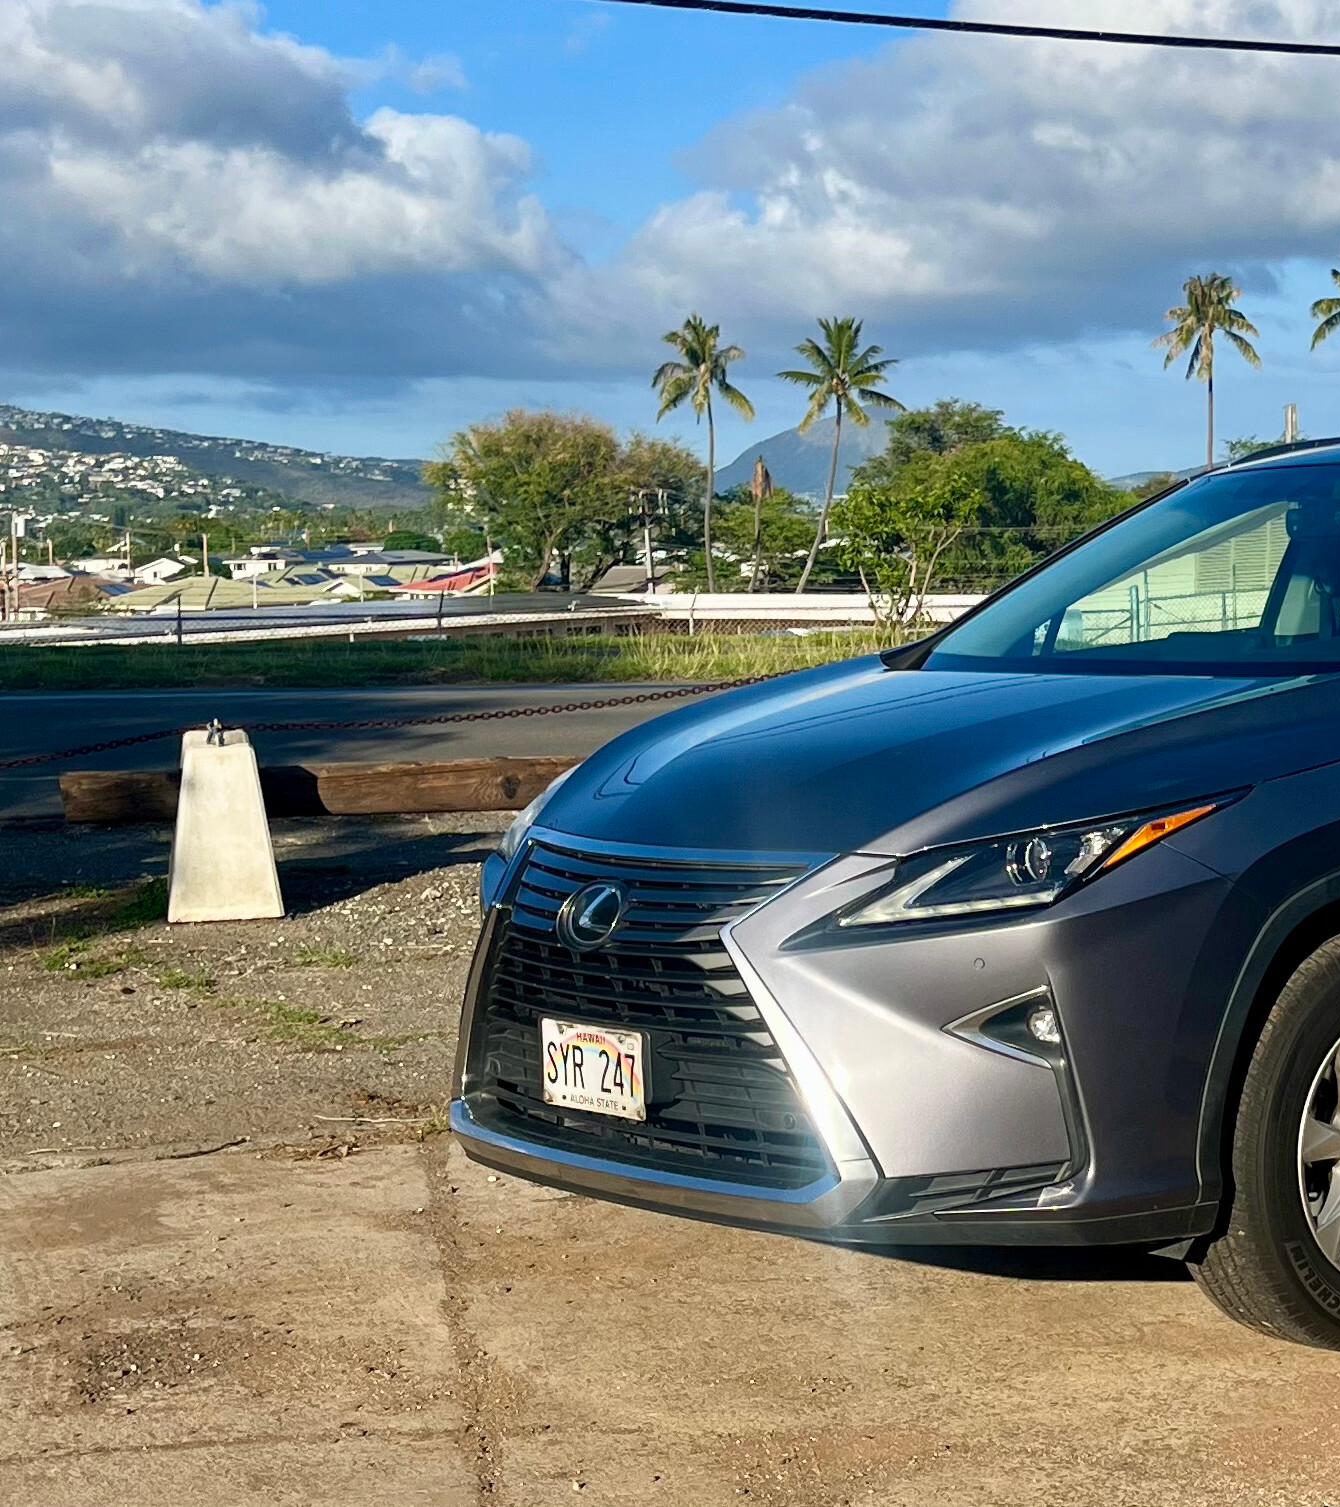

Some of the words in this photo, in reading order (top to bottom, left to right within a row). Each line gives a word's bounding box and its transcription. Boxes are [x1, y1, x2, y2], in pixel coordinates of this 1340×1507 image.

[576, 1032, 606, 1045] HAWAII
[547, 1041, 585, 1090] SYR
[599, 1049, 635, 1098] 247
[570, 1094, 595, 1106] ALOHA
[596, 1097, 619, 1111] STATE
